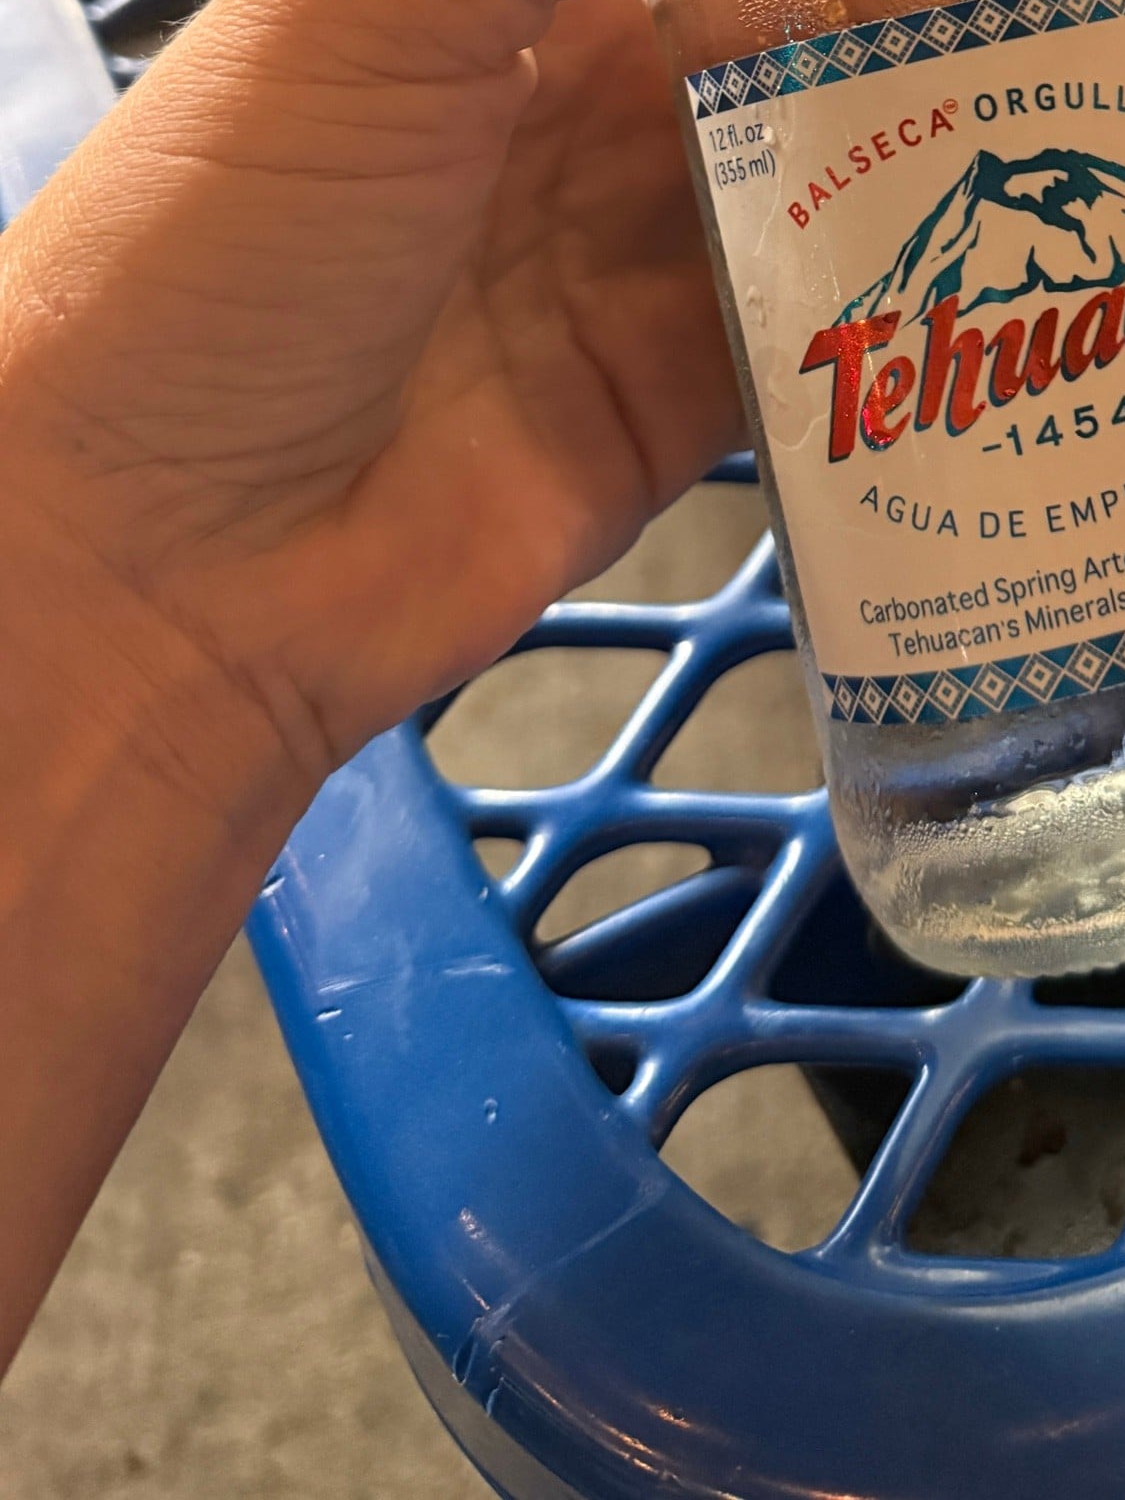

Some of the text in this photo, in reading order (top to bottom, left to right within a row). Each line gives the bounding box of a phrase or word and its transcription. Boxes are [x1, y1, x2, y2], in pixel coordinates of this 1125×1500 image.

[709, 126, 728, 153] 12
[745, 123, 764, 143] oz
[714, 149, 776, 191] (355 ml)
[860, 485, 960, 537] AGUA
[980, 510, 1027, 538] DE
[859, 583, 990, 625] Carbonated
[994, 567, 1077, 607] Spring
[888, 619, 1021, 658] Tehuacan's
